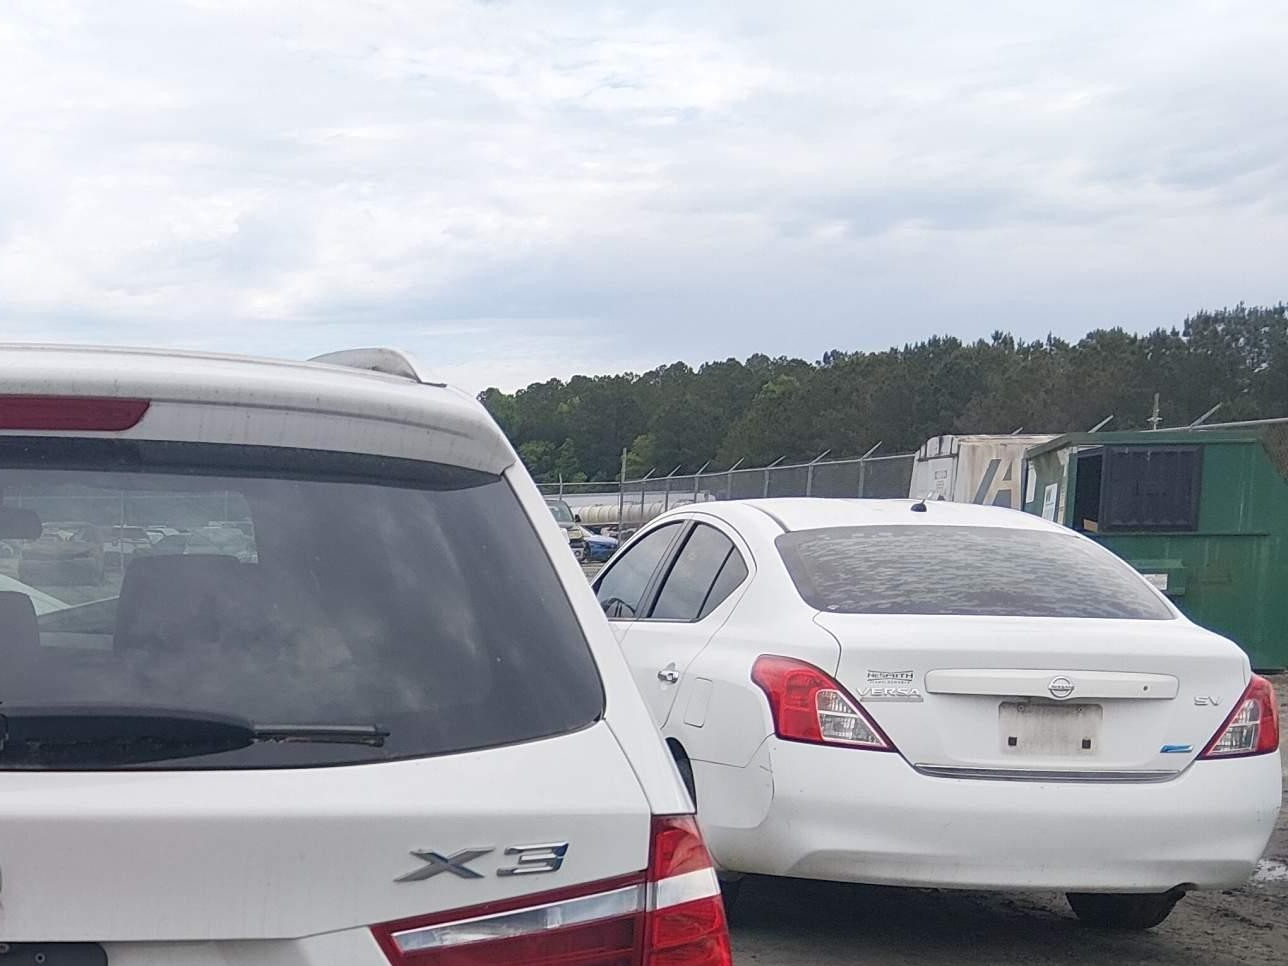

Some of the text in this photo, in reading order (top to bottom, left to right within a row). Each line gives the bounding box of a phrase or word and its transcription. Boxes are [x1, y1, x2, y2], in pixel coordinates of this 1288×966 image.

[856, 687, 921, 698] VERSA
[1194, 696, 1221, 706] SV
[393, 840, 569, 883] X3
